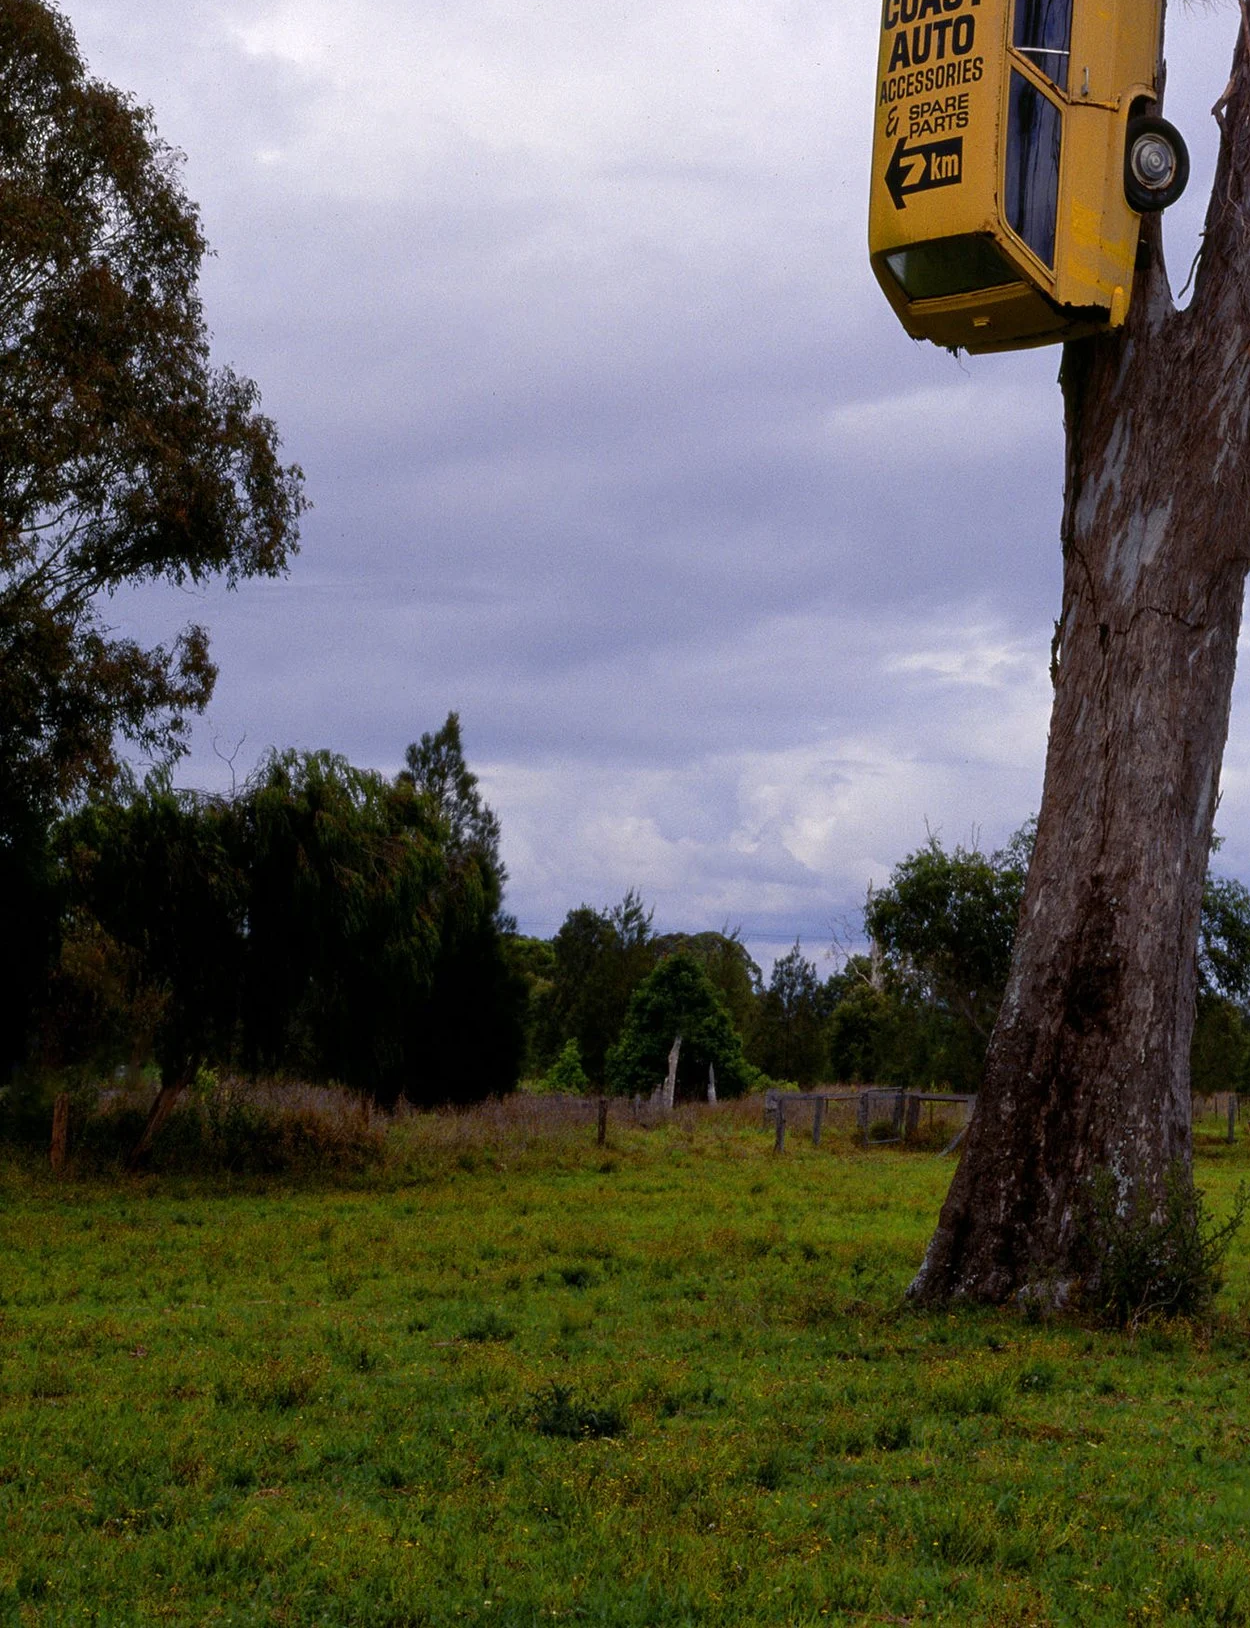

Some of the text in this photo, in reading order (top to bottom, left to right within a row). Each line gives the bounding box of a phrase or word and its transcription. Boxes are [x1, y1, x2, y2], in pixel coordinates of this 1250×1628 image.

[888, 13, 975, 73] AUTO
[879, 56, 984, 106] ACCESSORIES
[885, 93, 969, 138] & SPARE
[909, 110, 969, 139] PARTS
[930, 151, 959, 181] km
